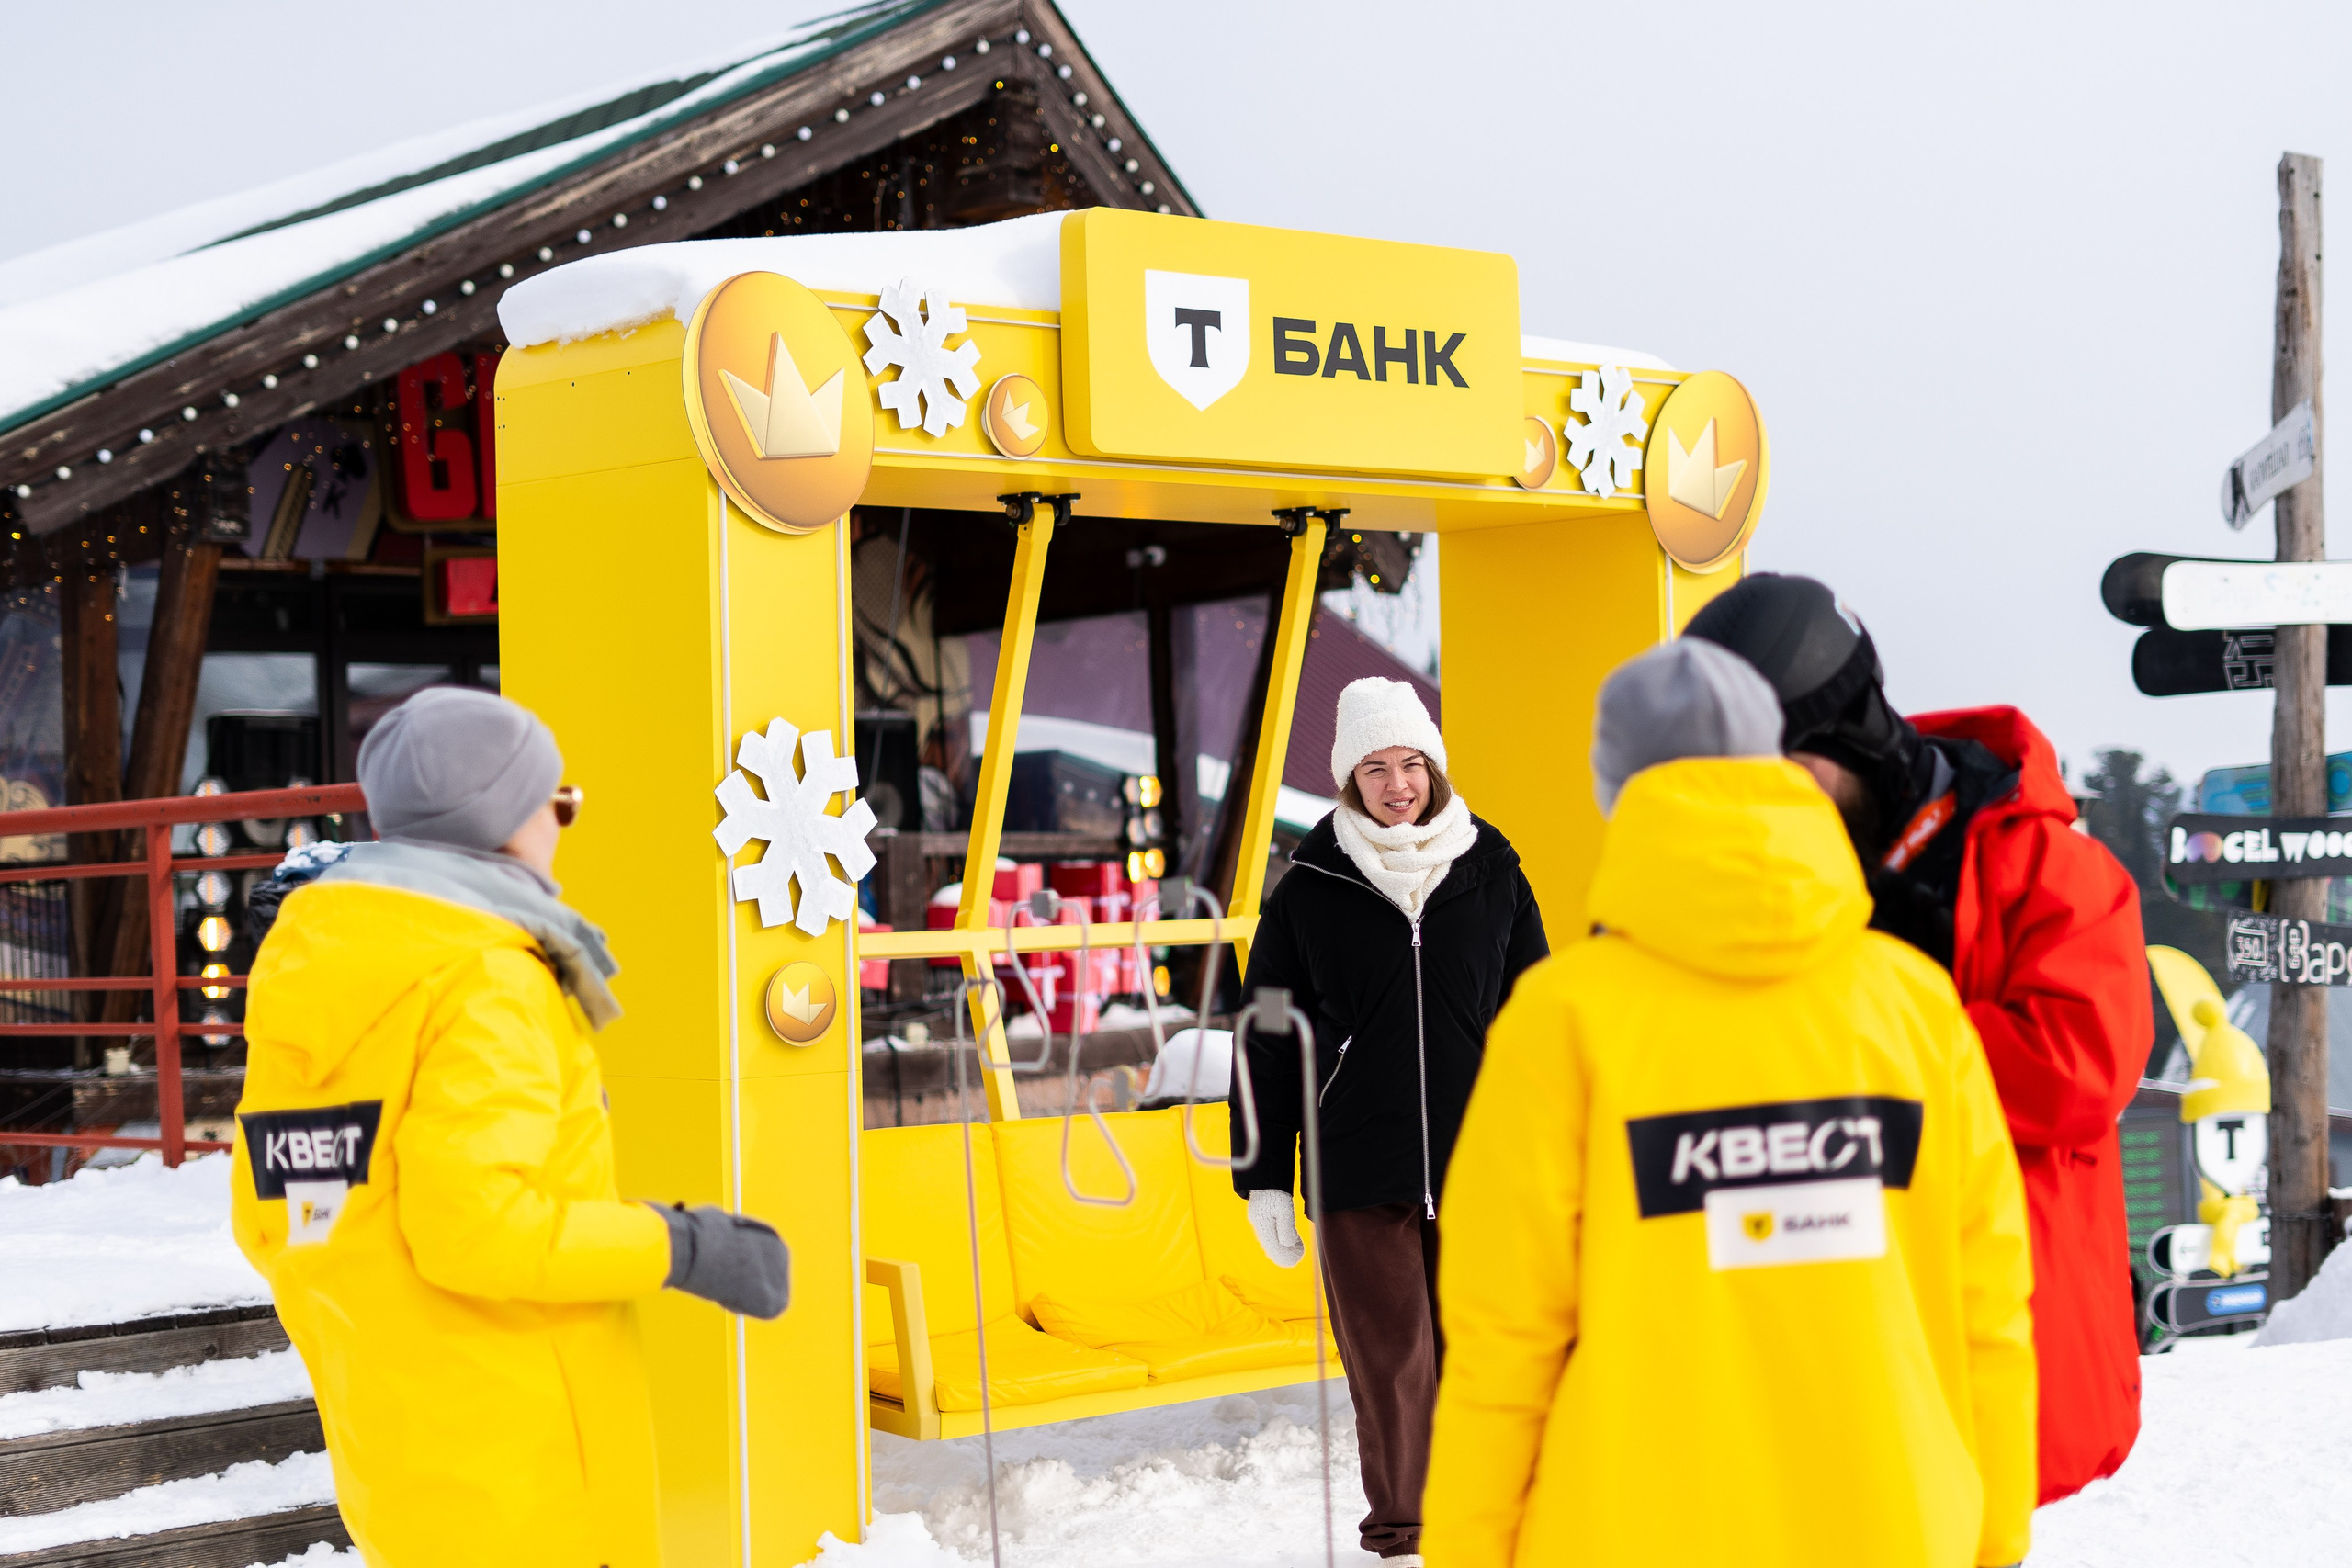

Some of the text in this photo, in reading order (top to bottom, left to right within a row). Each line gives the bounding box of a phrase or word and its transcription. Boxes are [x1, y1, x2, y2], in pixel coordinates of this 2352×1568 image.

[1175, 307, 1470, 389] Т БАНК
[266, 1126, 362, 1170] КВЕСТ
[1783, 1211, 1850, 1233] БАНК
